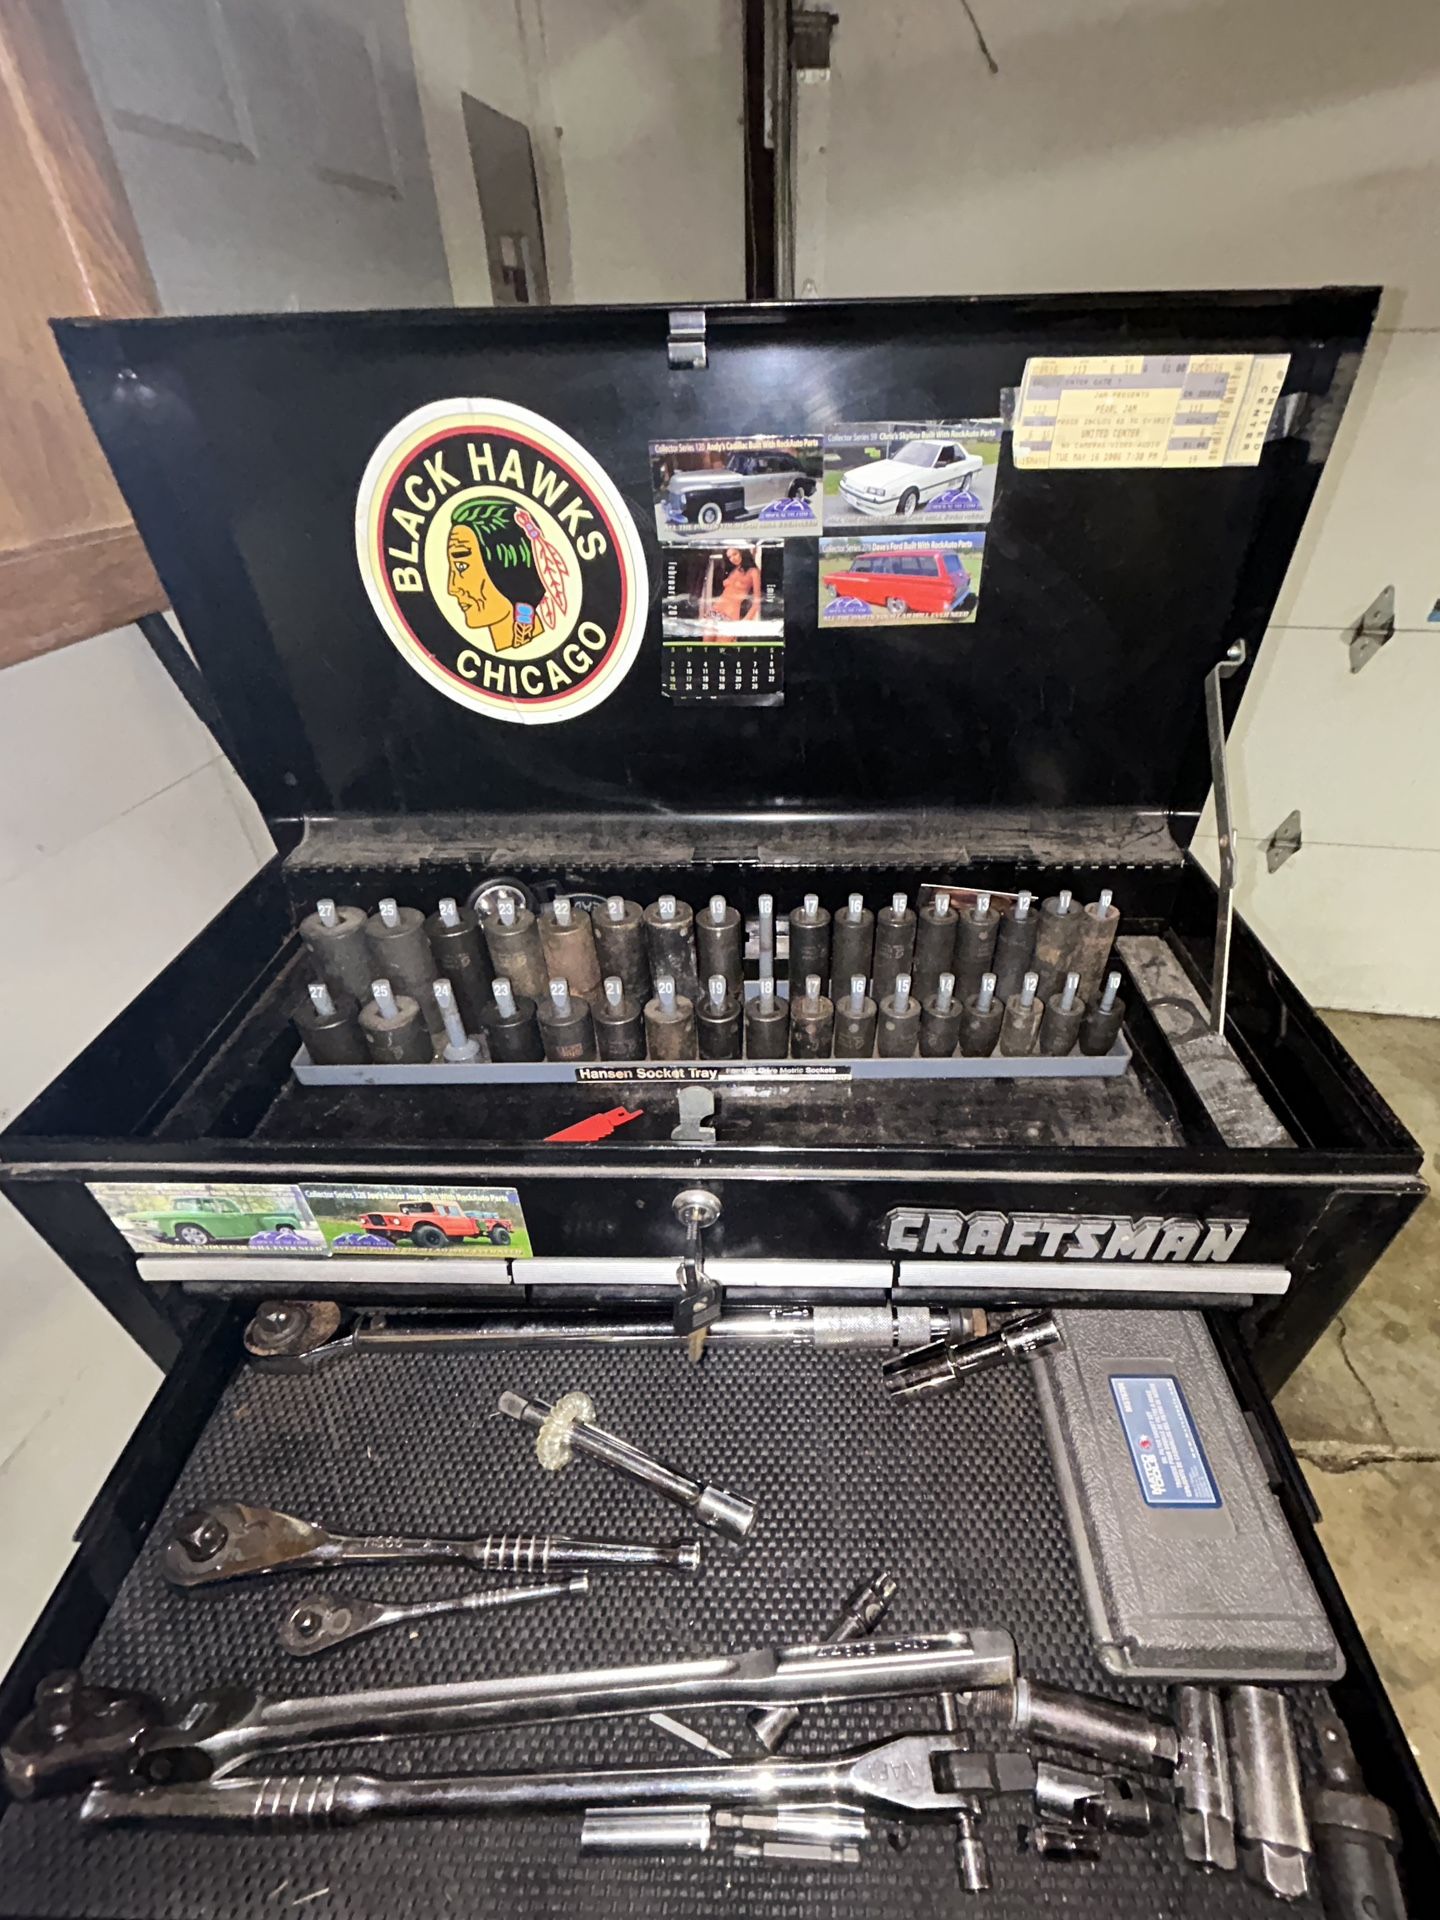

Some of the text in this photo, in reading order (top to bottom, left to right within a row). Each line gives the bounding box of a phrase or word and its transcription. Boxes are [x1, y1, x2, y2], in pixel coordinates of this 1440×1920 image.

[655, 445, 679, 453] Collector
[679, 444, 695, 452] Series
[749, 441, 762, 450] Built
[763, 440, 776, 449] With
[804, 439, 819, 447] Parts
[828, 434, 853, 442] Collector
[853, 433, 869, 441] Series
[921, 431, 935, 439] Built
[936, 430, 950, 438] With
[980, 429, 996, 437] Parts
[388, 442, 607, 593] BLACK HAWKS
[823, 544, 846, 553] Collector
[847, 544, 861, 552] Series
[872, 543, 890, 551] Dave's
[890, 542, 903, 550] Ford
[904, 541, 917, 550] Built
[918, 541, 930, 549] With
[959, 540, 973, 548] Parts
[456, 620, 606, 696] CHICAGO
[319, 905, 332, 917] 27
[380, 904, 394, 915] 25
[440, 904, 454, 915] 24
[499, 903, 513, 915] 23
[555, 903, 568, 914] 22
[610, 902, 623, 913] 21
[660, 901, 675, 912] 20
[712, 902, 723, 913] 19
[760, 901, 771, 913] 18
[806, 901, 817, 912] 17
[851, 901, 862, 912] 16
[895, 901, 906, 912] 15
[937, 899, 948, 910] 14
[978, 898, 989, 909] 13
[1019, 897, 1030, 909] 12
[1061, 896, 1070, 907] 11
[1102, 896, 1112, 907] 10
[310, 977, 1119, 998] 27 25 24 23 22 21 20 19 18 17 16 15 14 13 12 11 10
[579, 1068, 718, 1081] Hansen Socket Tray
[305, 1190, 334, 1199] Collector
[334, 1190, 354, 1199] Series
[490, 1194, 509, 1202] Parts
[885, 1207, 1250, 1262] CRAFTSMAN
[1140, 1454, 1162, 1495] MATCO
[1148, 1454, 1167, 1492] TOOLS
